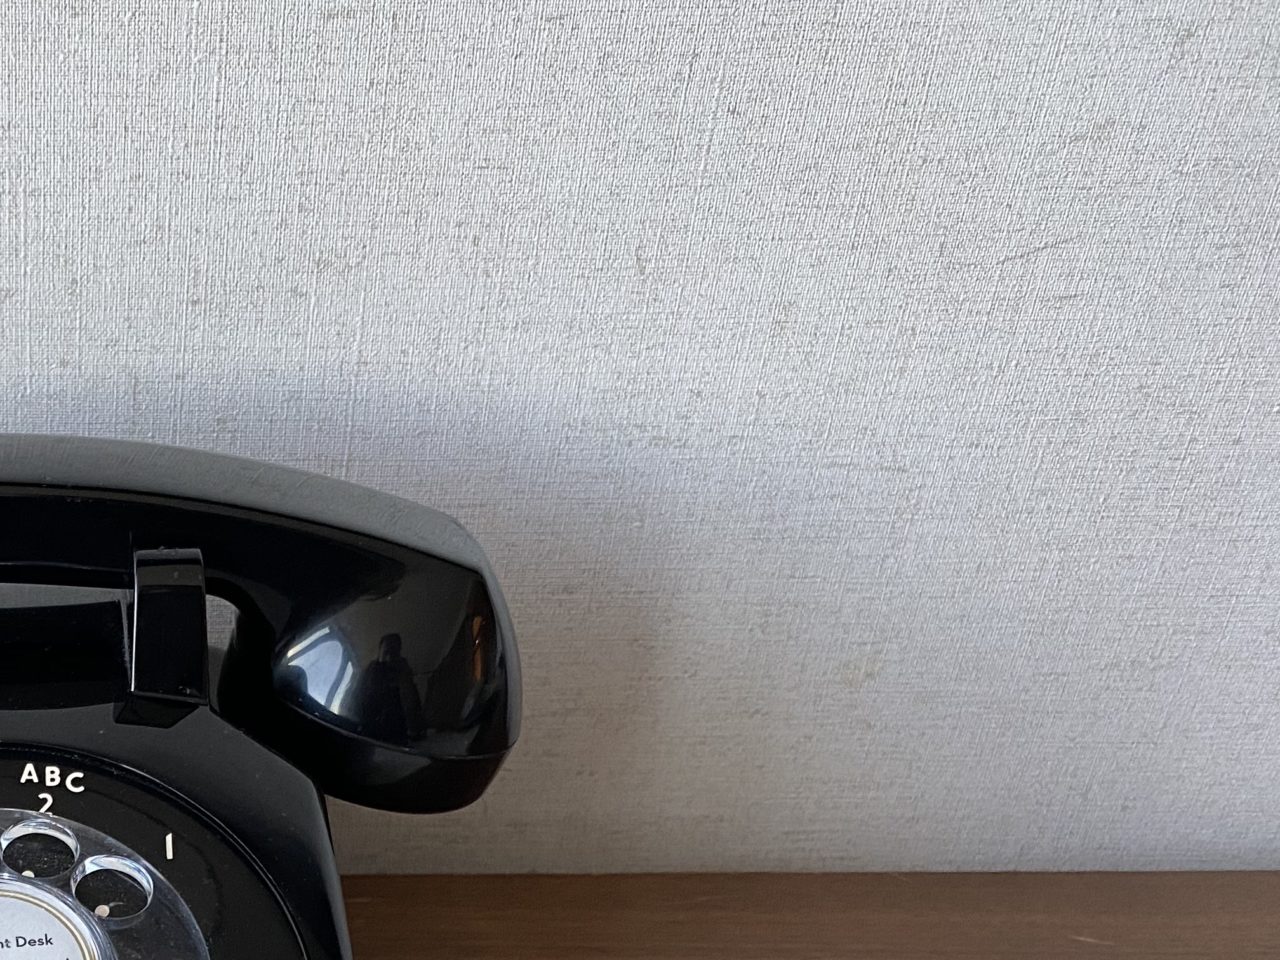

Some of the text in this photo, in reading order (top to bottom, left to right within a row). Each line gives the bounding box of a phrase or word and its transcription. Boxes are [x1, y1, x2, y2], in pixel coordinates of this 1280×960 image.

[19, 762, 86, 794] ABC
[38, 793, 54, 816] 2
[15, 933, 54, 948] Desk
